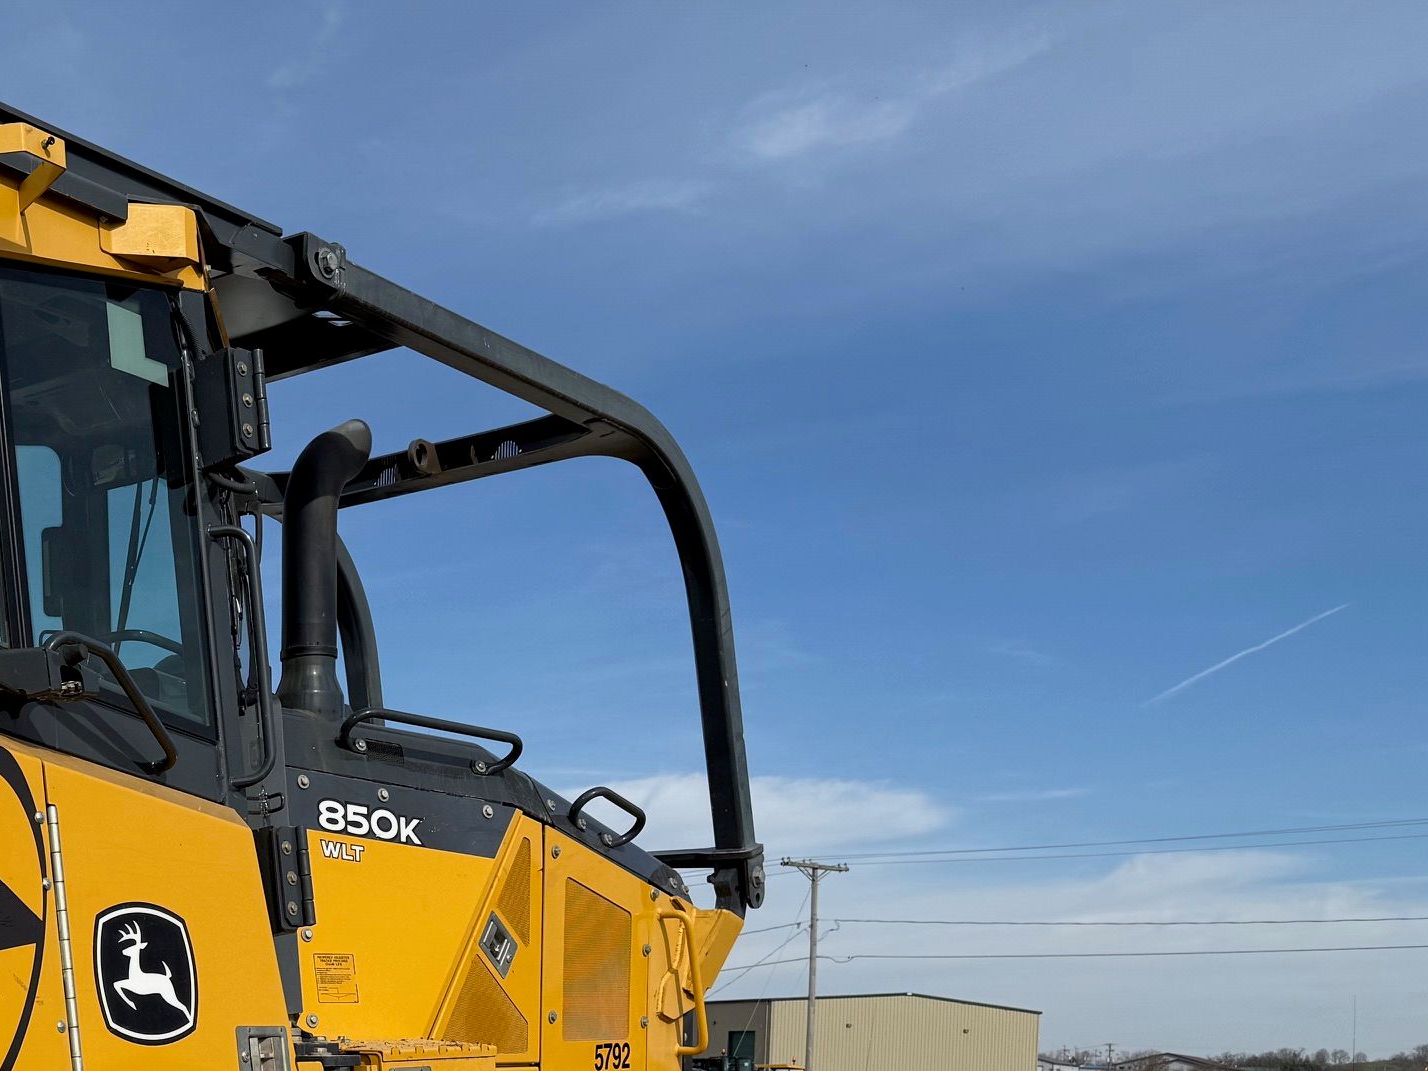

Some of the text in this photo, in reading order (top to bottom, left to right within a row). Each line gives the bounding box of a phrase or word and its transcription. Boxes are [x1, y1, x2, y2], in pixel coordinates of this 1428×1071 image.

[317, 799, 422, 845] 850K
[320, 839, 365, 862] WLT
[594, 1042, 631, 1071] 5792
